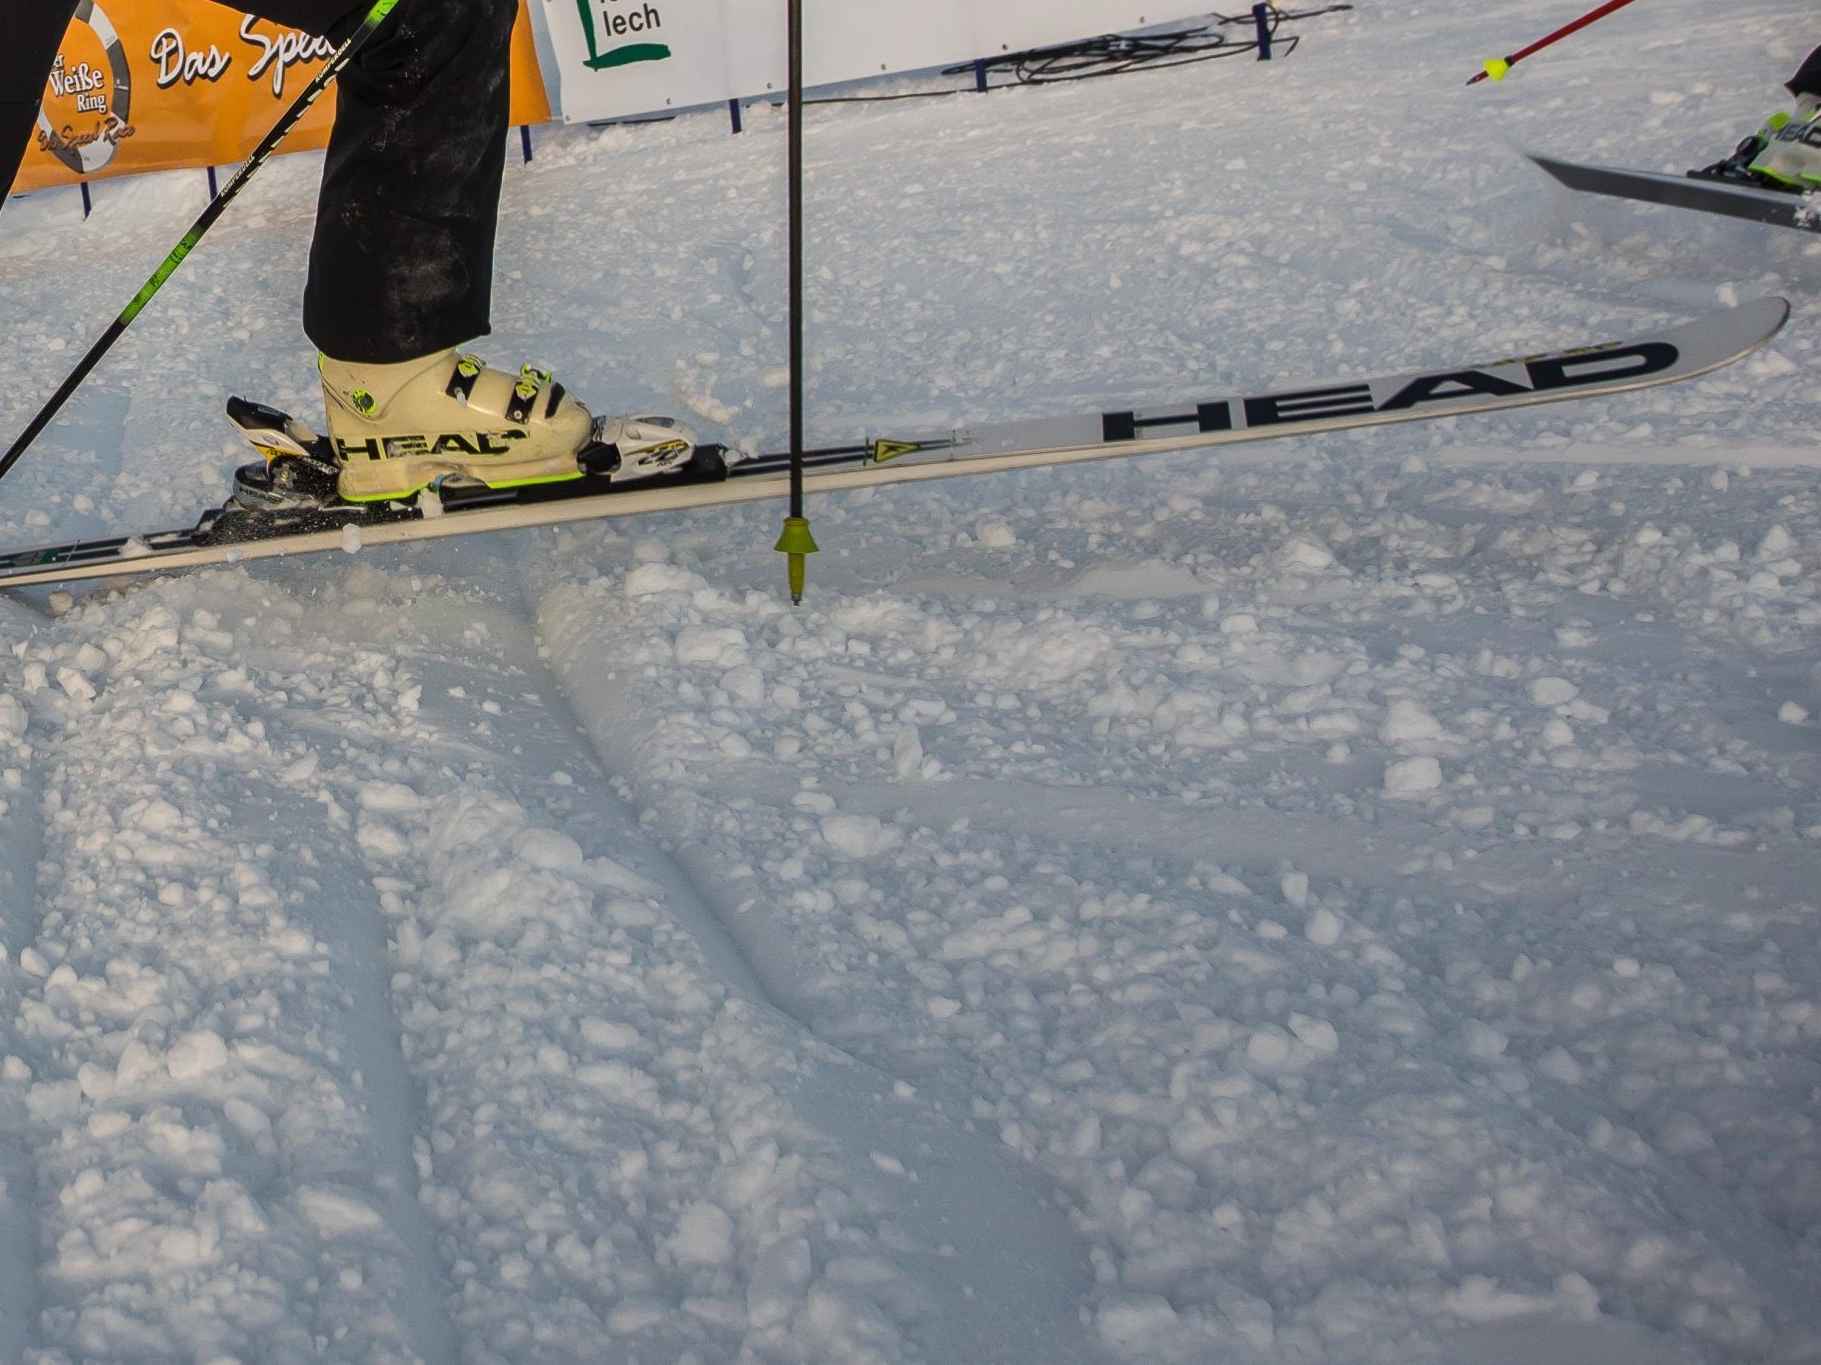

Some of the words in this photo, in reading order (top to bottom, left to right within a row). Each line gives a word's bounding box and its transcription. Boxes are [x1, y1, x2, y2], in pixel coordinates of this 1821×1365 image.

[603, 3, 661, 37] lech
[150, 28, 230, 87] Das
[49, 62, 104, 96] Weiße
[76, 93, 108, 114] Ring
[1103, 342, 1678, 442] HEAD
